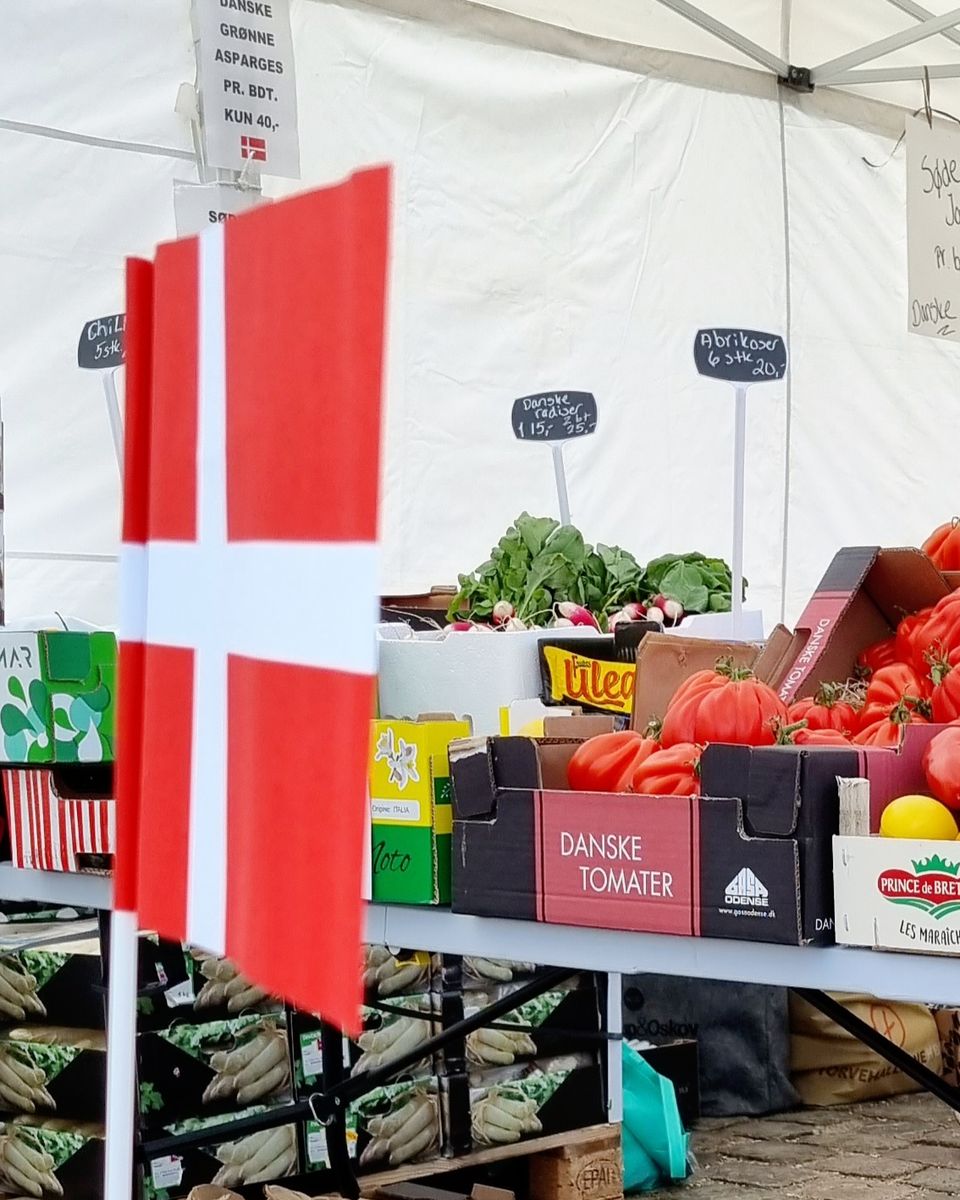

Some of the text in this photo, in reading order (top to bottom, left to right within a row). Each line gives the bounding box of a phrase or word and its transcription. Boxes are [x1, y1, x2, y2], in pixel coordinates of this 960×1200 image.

[220, 0, 273, 18] DANSKE
[220, 23, 275, 47] GRØNNE
[214, 48, 284, 74] ASPARGES
[223, 79, 278, 102] PR. BDT.
[224, 108, 280, 132] KUN 40,-
[701, 330, 779, 351] Abrikoser
[708, 351, 753, 367] 6 stk
[752, 358, 785, 378] 20,-
[523, 394, 570, 411] Danske
[799, 618, 830, 663] DANSKE
[561, 832, 642, 861] DANSKE
[579, 866, 674, 898] TOMATER
[881, 878, 920, 894] PRINCE
[921, 882, 932, 895] de
[724, 895, 769, 907] ODENSE
[900, 920, 916, 940] LES
